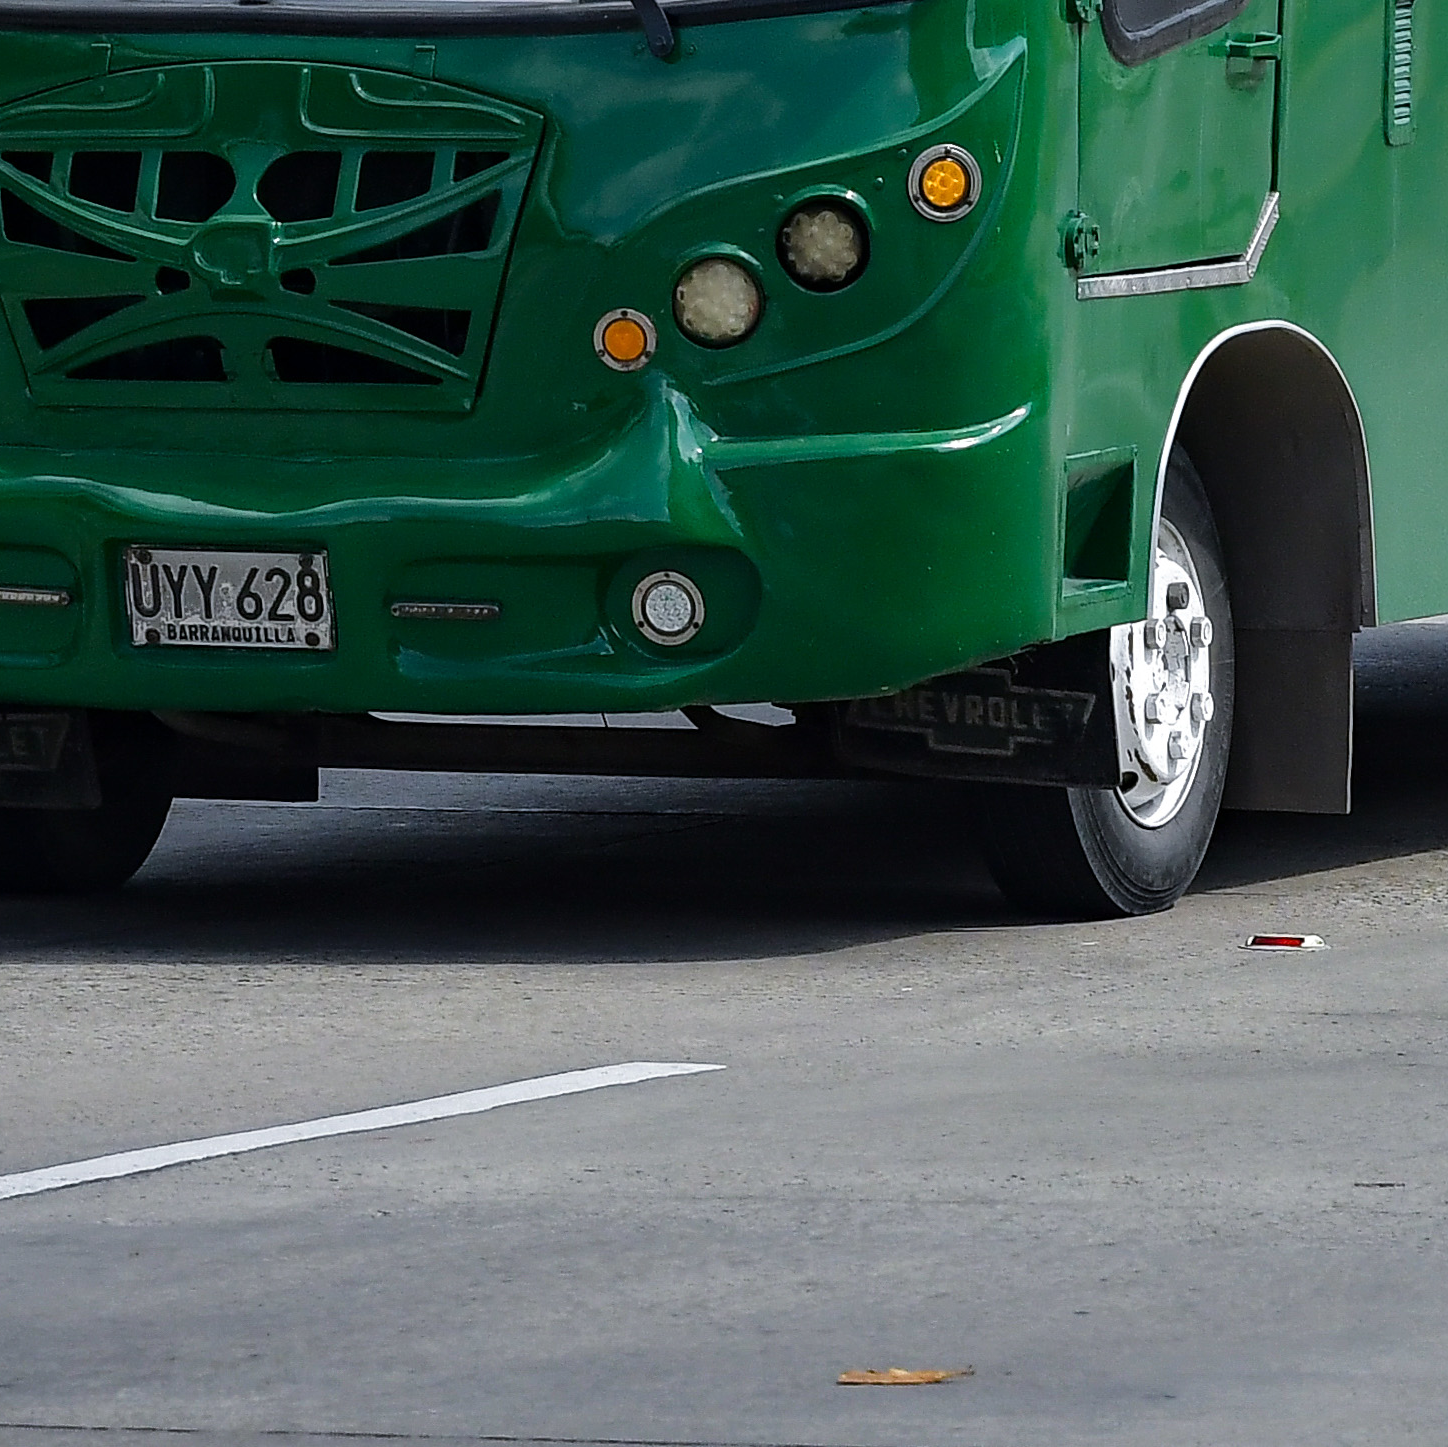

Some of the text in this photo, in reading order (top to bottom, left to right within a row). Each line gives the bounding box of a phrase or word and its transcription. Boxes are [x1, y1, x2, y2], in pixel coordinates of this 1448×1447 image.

[131, 563, 324, 622] UYY 628
[167, 624, 296, 642] BARRANQUILLA
